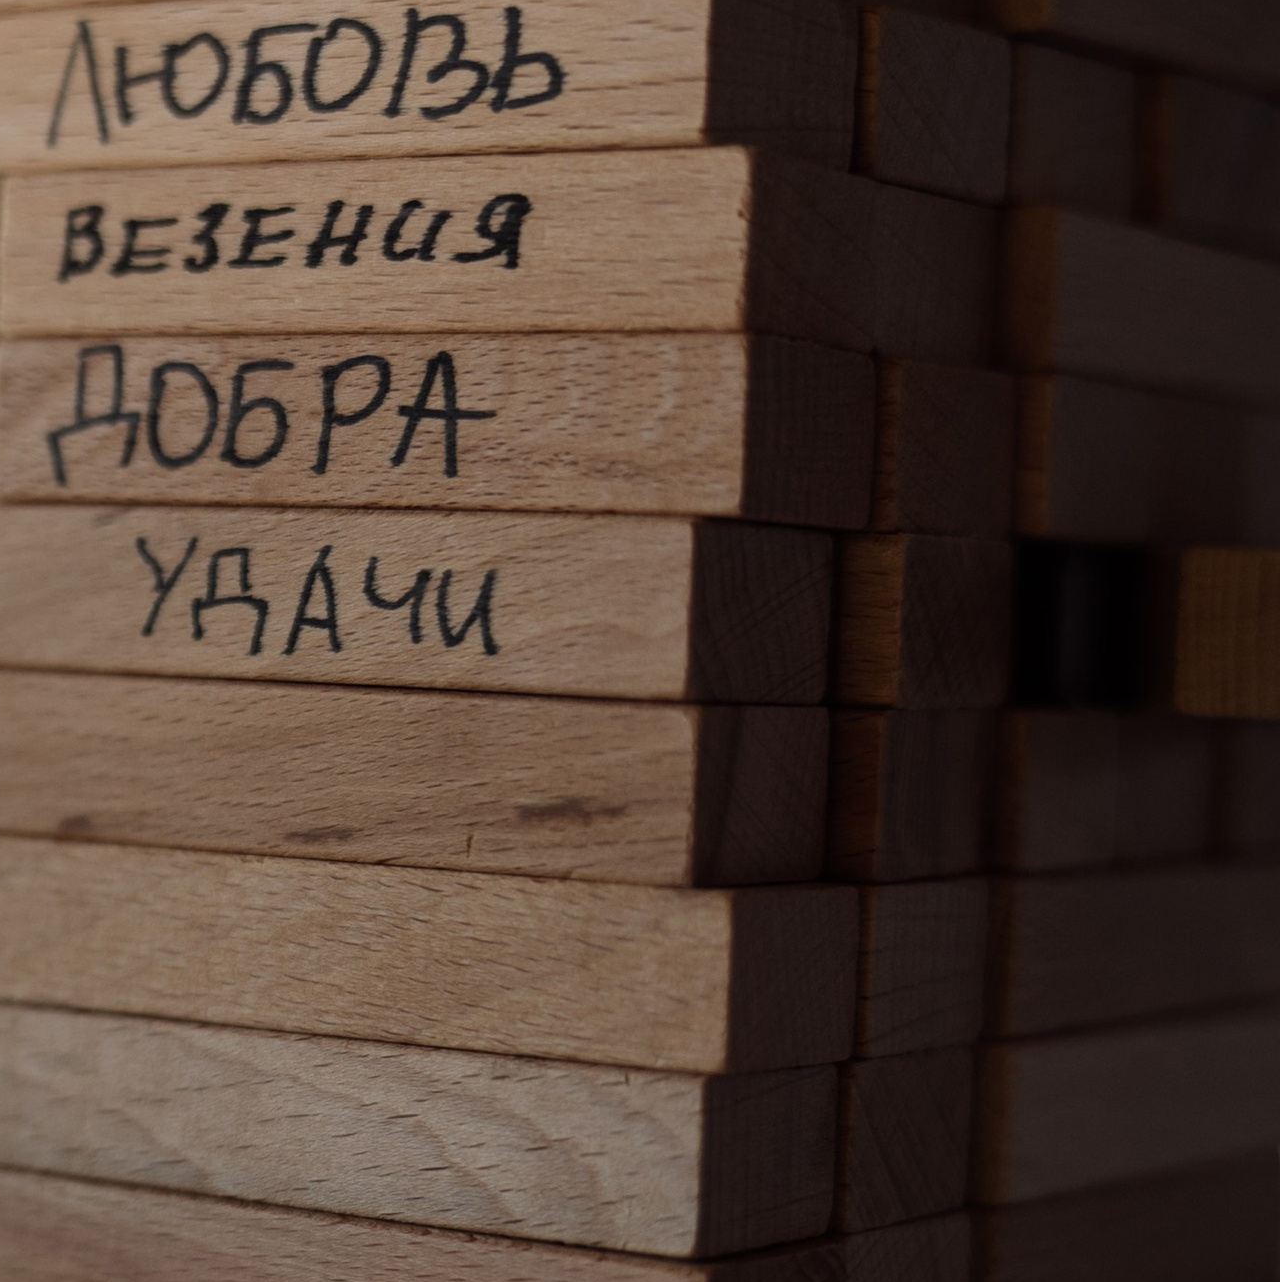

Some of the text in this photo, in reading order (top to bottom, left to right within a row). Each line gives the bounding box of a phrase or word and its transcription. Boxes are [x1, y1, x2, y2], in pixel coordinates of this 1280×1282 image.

[46, 4, 566, 147] ЛЮБОВЬ
[56, 192, 533, 283] ВЕЗЕНИЯ
[46, 343, 498, 486] ДОБРА
[135, 534, 500, 657] УДАЧИ
